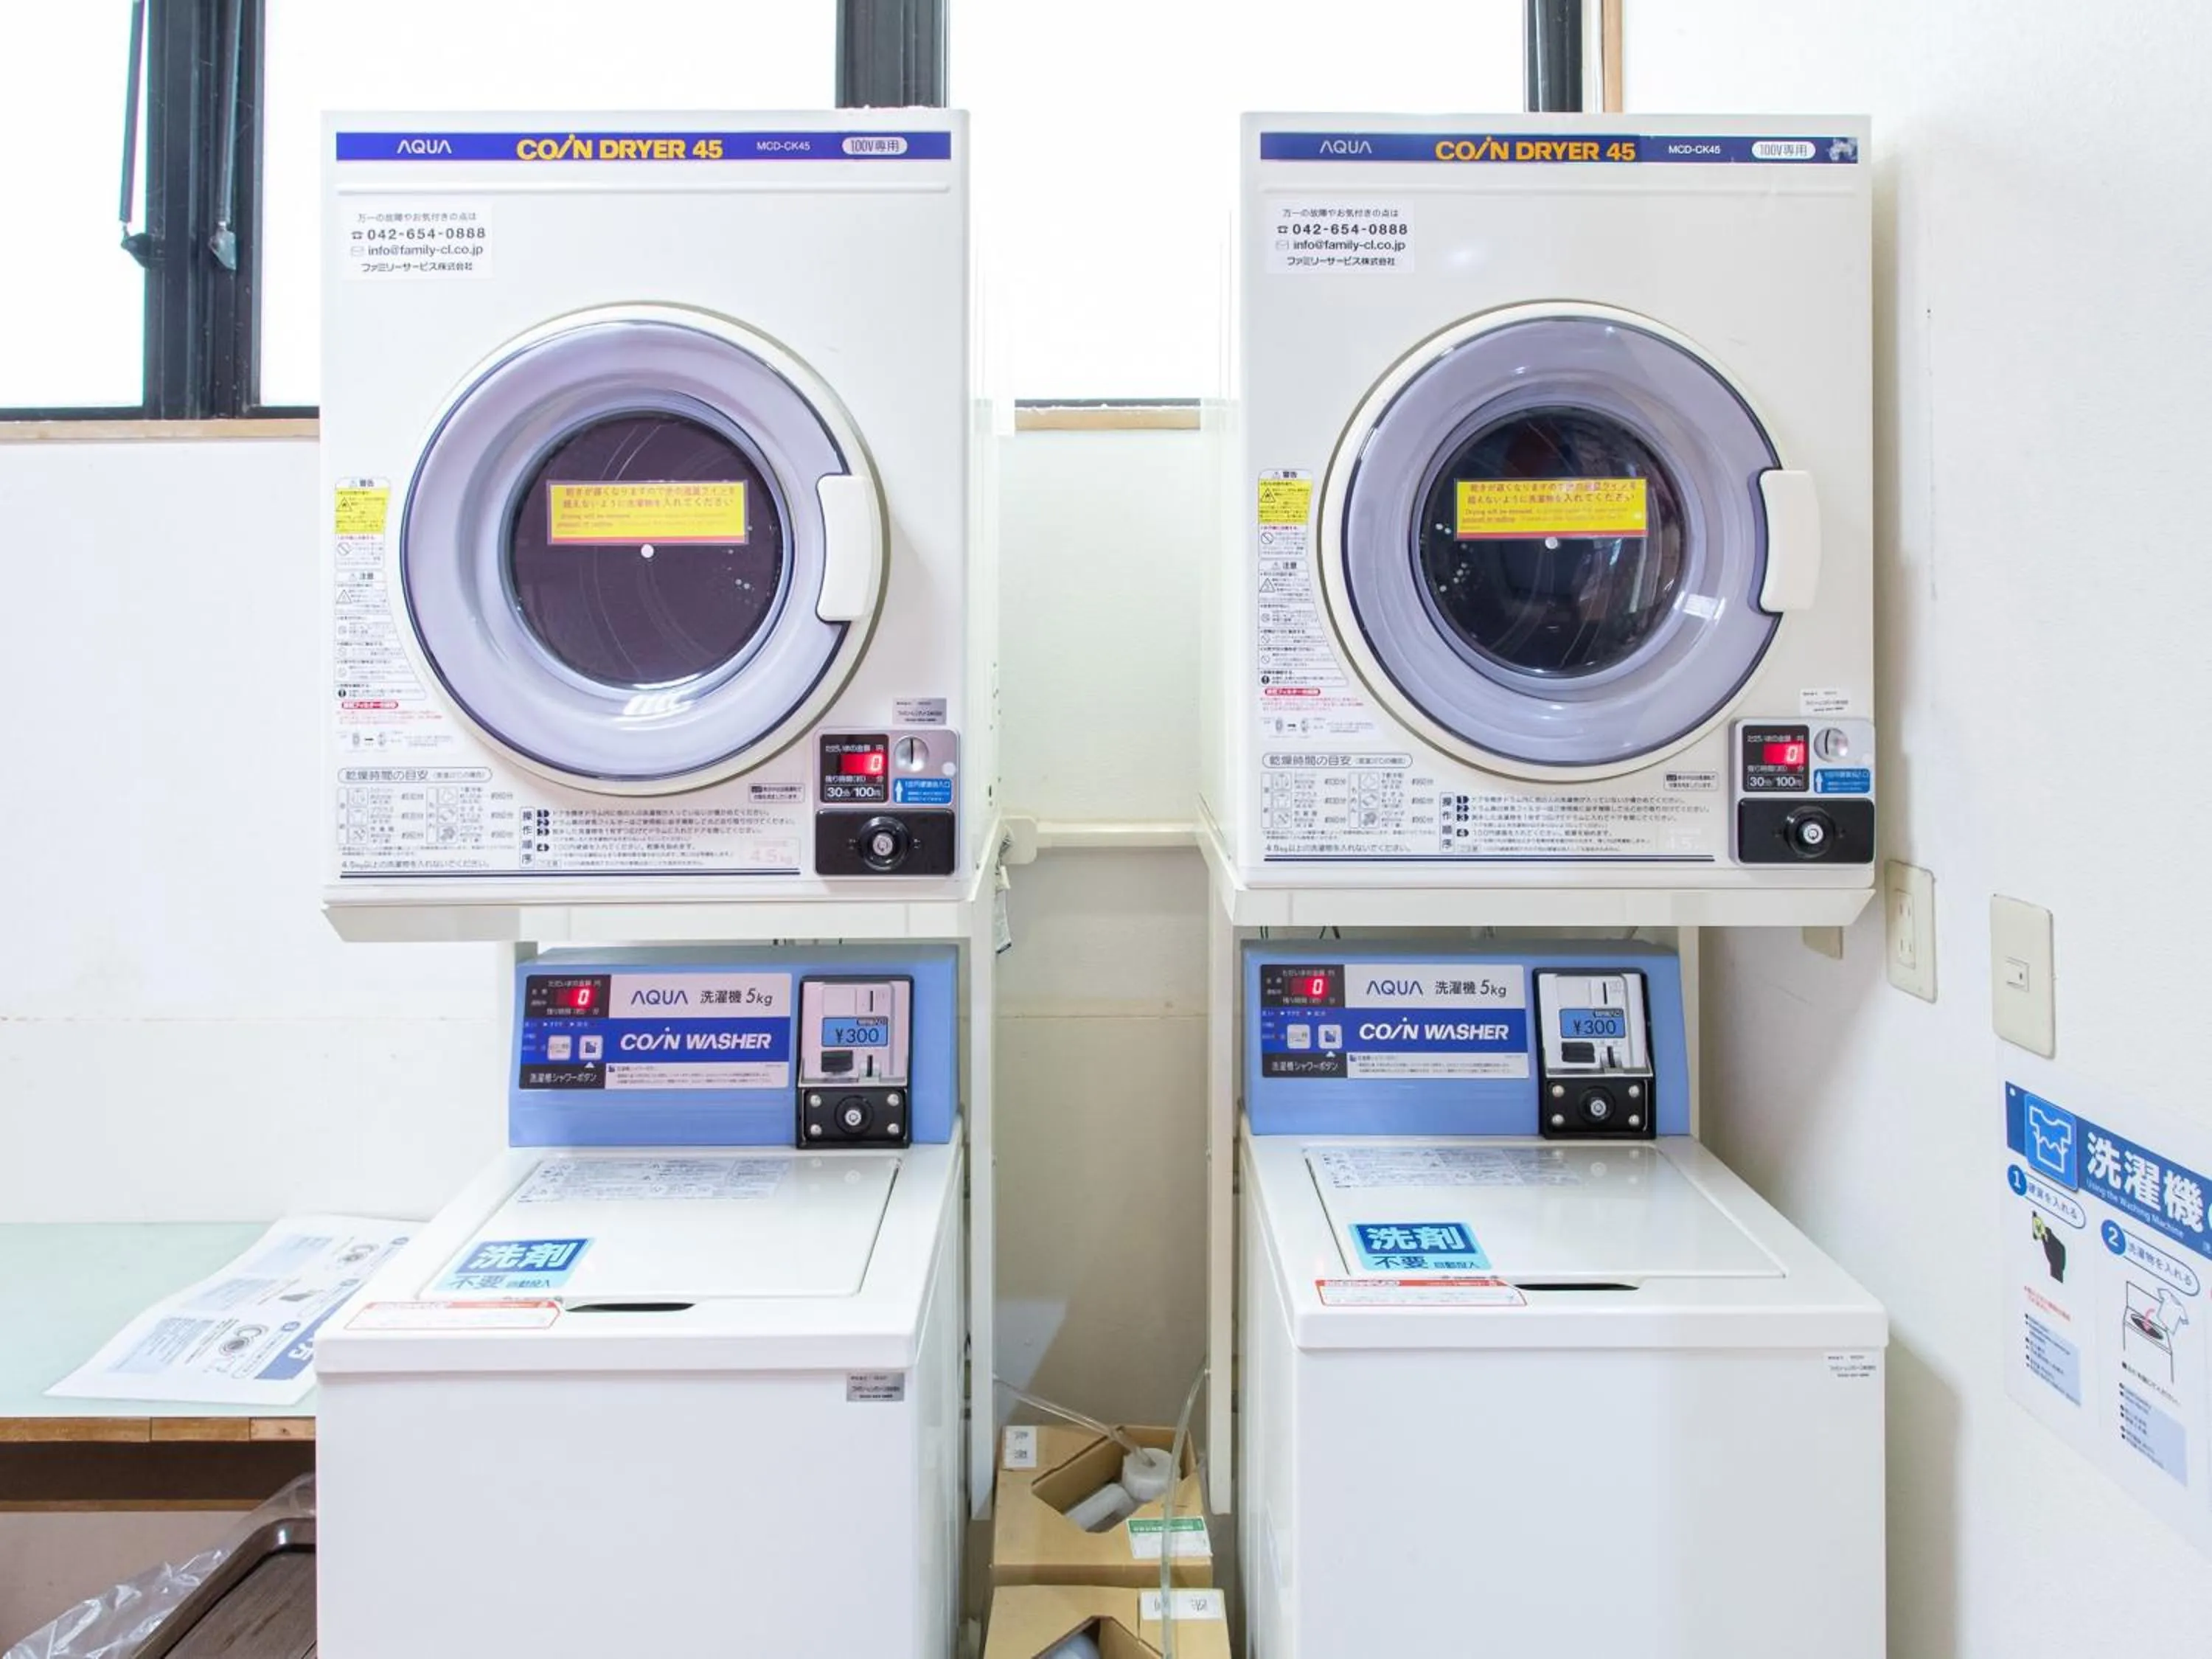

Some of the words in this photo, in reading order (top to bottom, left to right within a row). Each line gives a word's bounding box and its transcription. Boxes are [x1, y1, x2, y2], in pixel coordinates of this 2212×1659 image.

[397, 139, 452, 154] AQUA
[516, 134, 592, 160] COIN
[599, 139, 685, 159] DRYER
[692, 139, 723, 159] 45
[757, 141, 810, 151] MCD-CK45
[1319, 140, 1372, 154] AQUA
[1436, 136, 1509, 161] COIN
[1516, 142, 1599, 160] DRYER
[1607, 142, 1635, 161] 45
[1669, 145, 1720, 155] MCD-CK45
[367, 228, 487, 240] 042-654-0888
[1292, 224, 1408, 235] 042-654-0888
[368, 244, 484, 257] info@family-cl.co.jp
[1293, 240, 1406, 251] info@family-cl.co.jp
[1270, 756, 1352, 766] 乾燥時間の目安
[1786, 745, 1798, 763] 0
[870, 754, 883, 771] 0
[346, 770, 428, 780] 乾燥時間の目安
[1312, 978, 1324, 995] 0
[1366, 980, 1424, 995] AQUA
[1435, 981, 1477, 995] 洗濯機
[1480, 979, 1506, 997] 5kg
[577, 989, 590, 1005] 0
[631, 990, 689, 1005] AQUA
[700, 990, 742, 1004] 洗濯機
[745, 987, 773, 1006] 5kg
[835, 1028, 879, 1043] ¥300
[1359, 1017, 1419, 1040] COIN
[1425, 1023, 1509, 1040] WASHER
[1573, 1020, 1616, 1035] ¥300
[620, 1026, 679, 1051] COIN
[686, 1032, 772, 1050] WASHER
[2013, 1170, 2022, 1189] 1
[2087, 1132, 2212, 1234] 洗濯機
[2107, 1190, 2118, 1202] the
[2120, 1197, 2151, 1223] Washing
[2152, 1214, 2184, 1238] Machine
[1366, 1226, 1467, 1251] 洗剤
[470, 1242, 579, 1269] 洗剤
[1374, 1256, 1429, 1269] 不要
[2108, 1226, 2119, 1246] 2
[2128, 1242, 2193, 1287] 洗濯物を入れる
[449, 1275, 507, 1289] 不要
